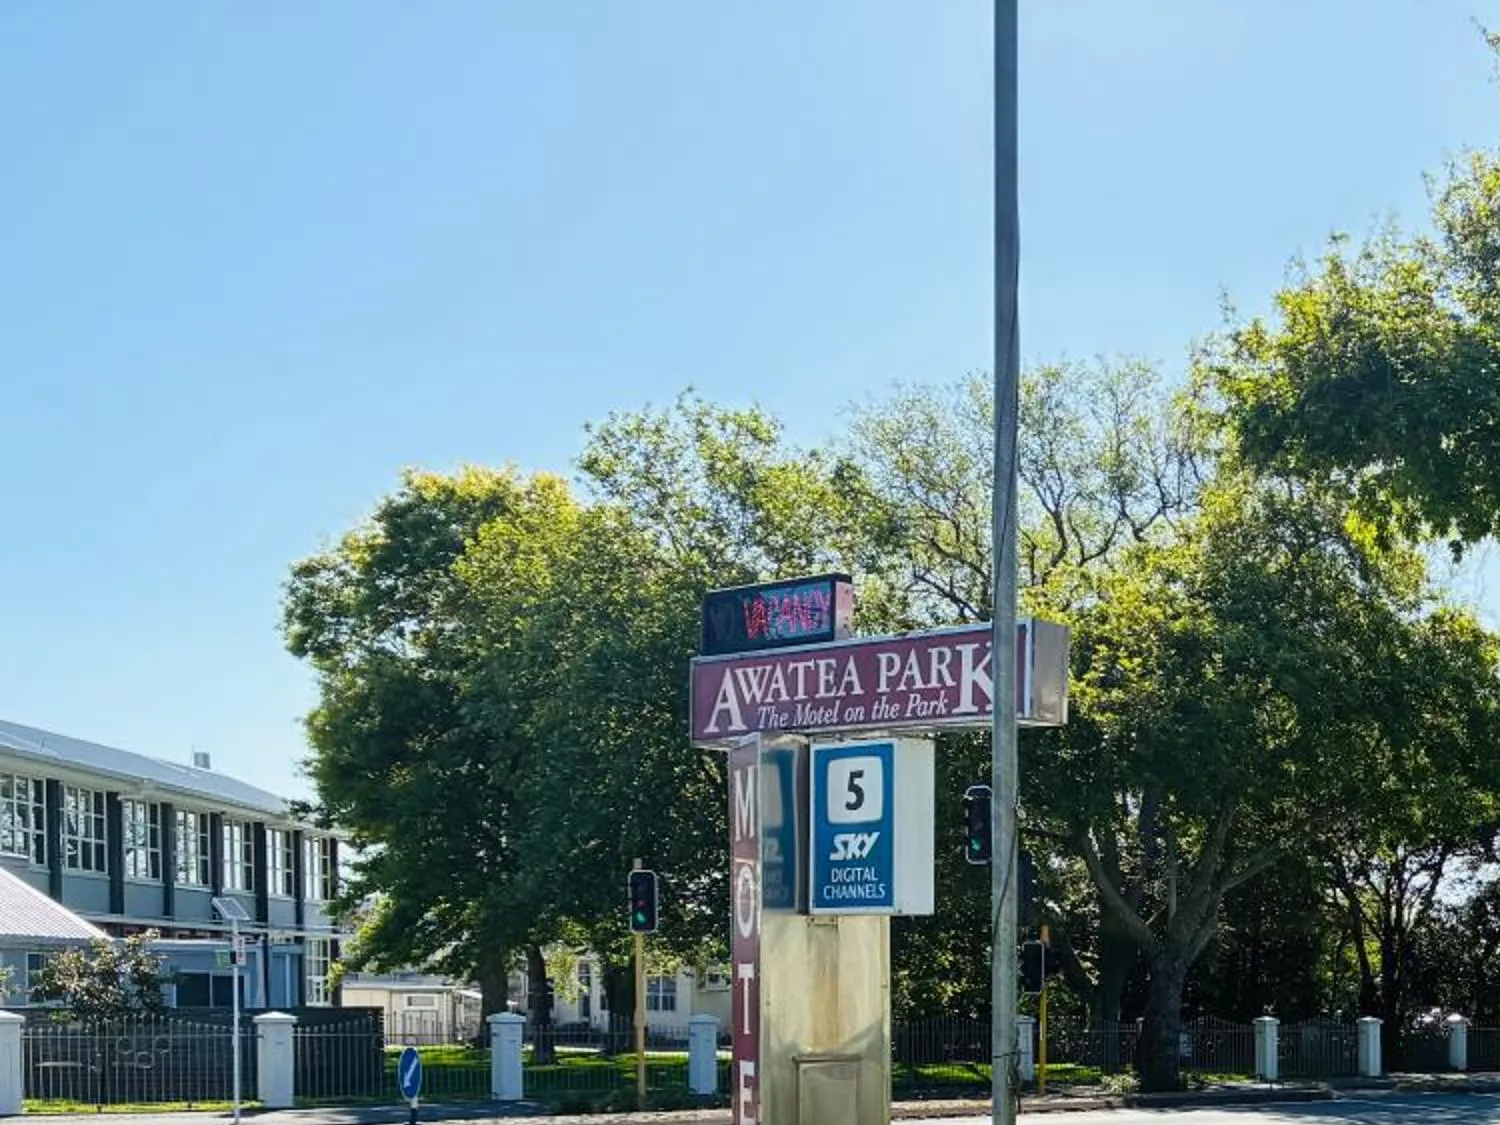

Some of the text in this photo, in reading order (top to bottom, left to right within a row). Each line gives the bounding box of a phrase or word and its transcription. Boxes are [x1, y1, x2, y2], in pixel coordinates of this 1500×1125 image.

[703, 642, 993, 733] AWATEA PARK
[757, 690, 948, 729] The Motel on the Park
[845, 770, 865, 810] 5
[829, 832, 881, 861] SKY
[823, 883, 887, 899] CHANNELS
[831, 867, 879, 883] DIGITAL
